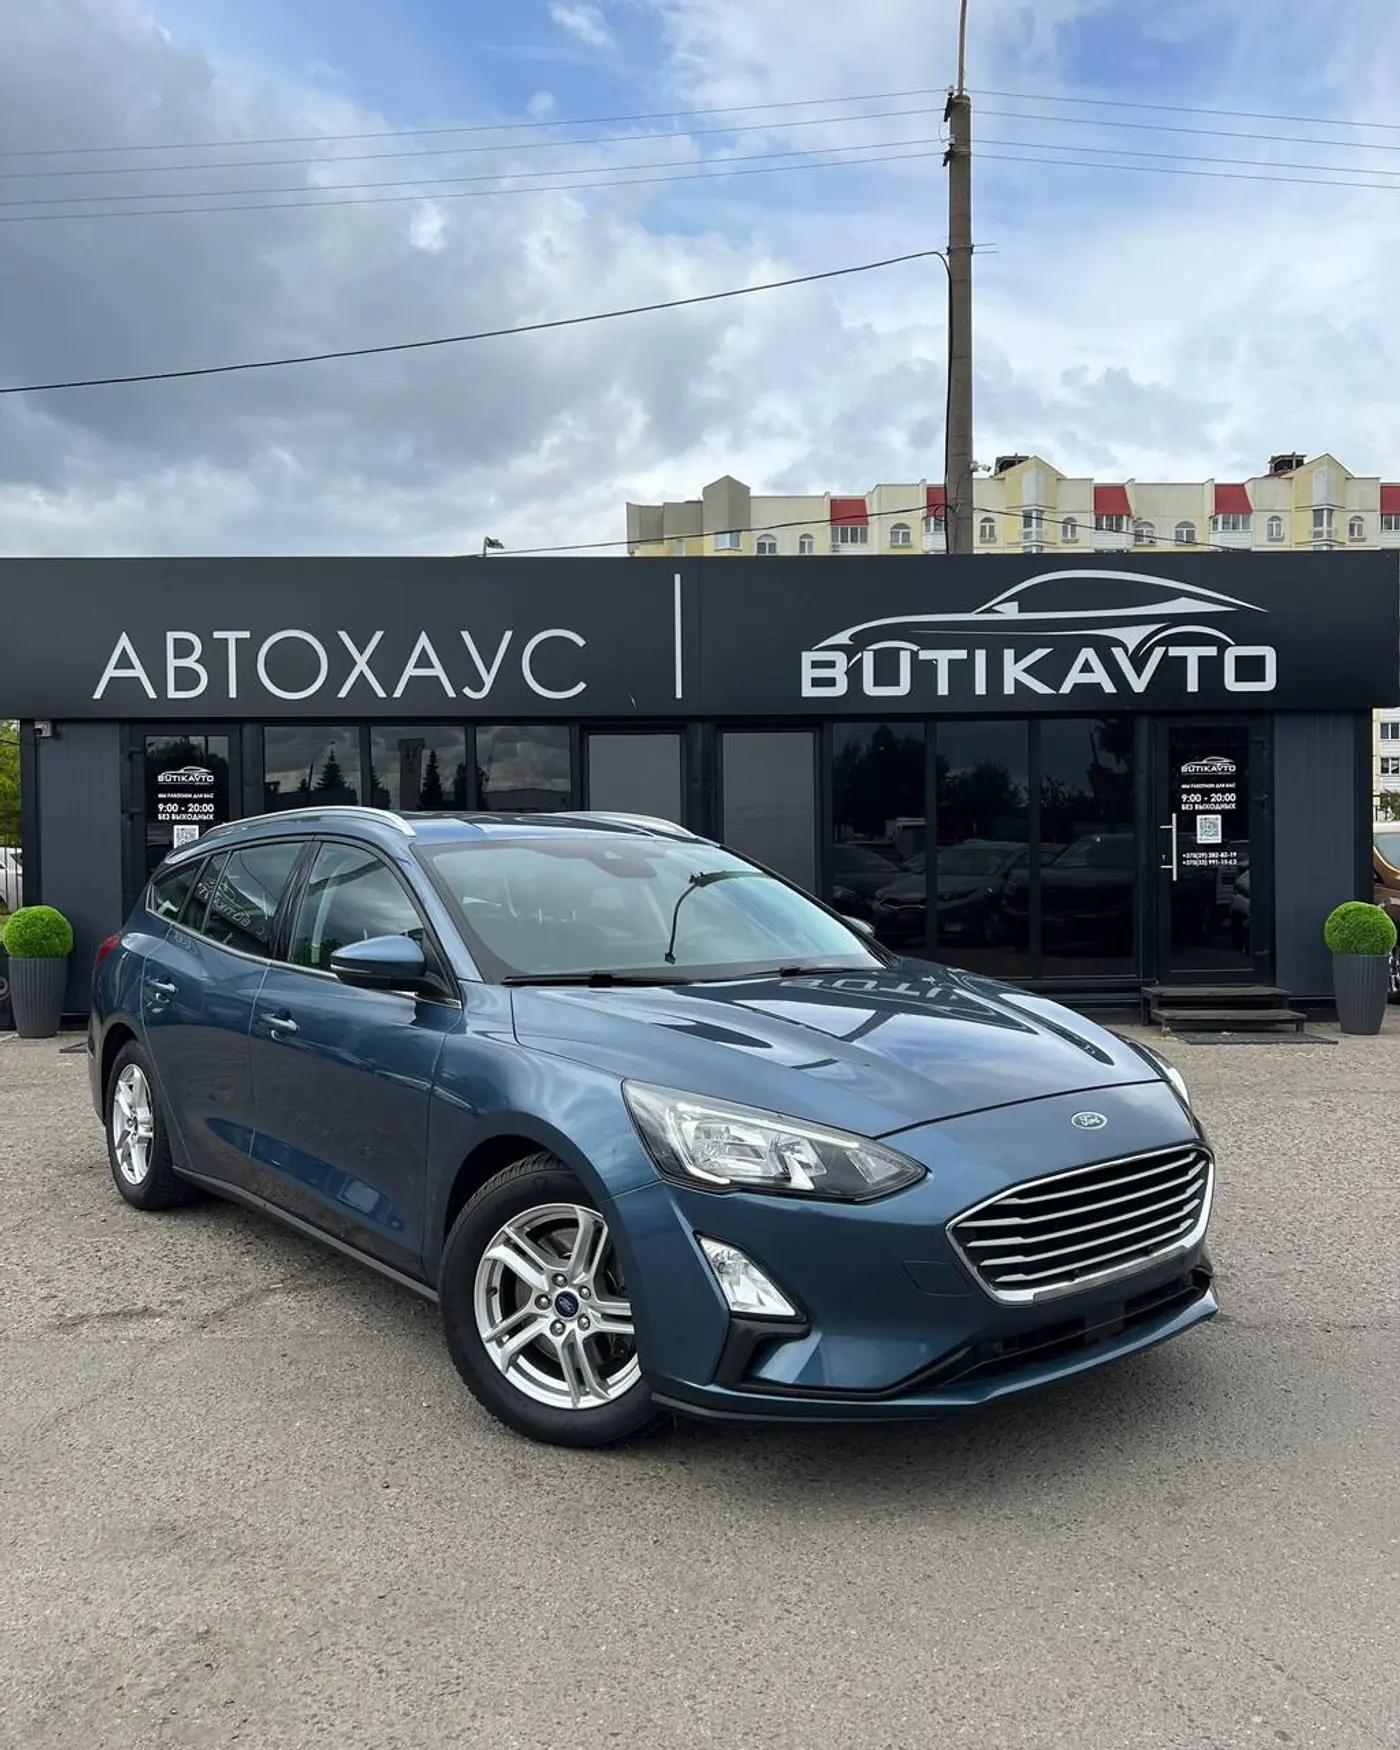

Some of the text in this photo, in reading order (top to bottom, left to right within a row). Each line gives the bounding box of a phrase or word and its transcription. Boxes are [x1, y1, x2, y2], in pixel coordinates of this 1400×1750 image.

[93, 628, 587, 700] АВТОХАУС
[801, 644, 1277, 698] BUTIKAVTO
[158, 803, 179, 813] 9:00
[188, 803, 214, 813] 20:00
[1181, 793, 1202, 803] 9:00
[1210, 793, 1236, 802] 20:00
